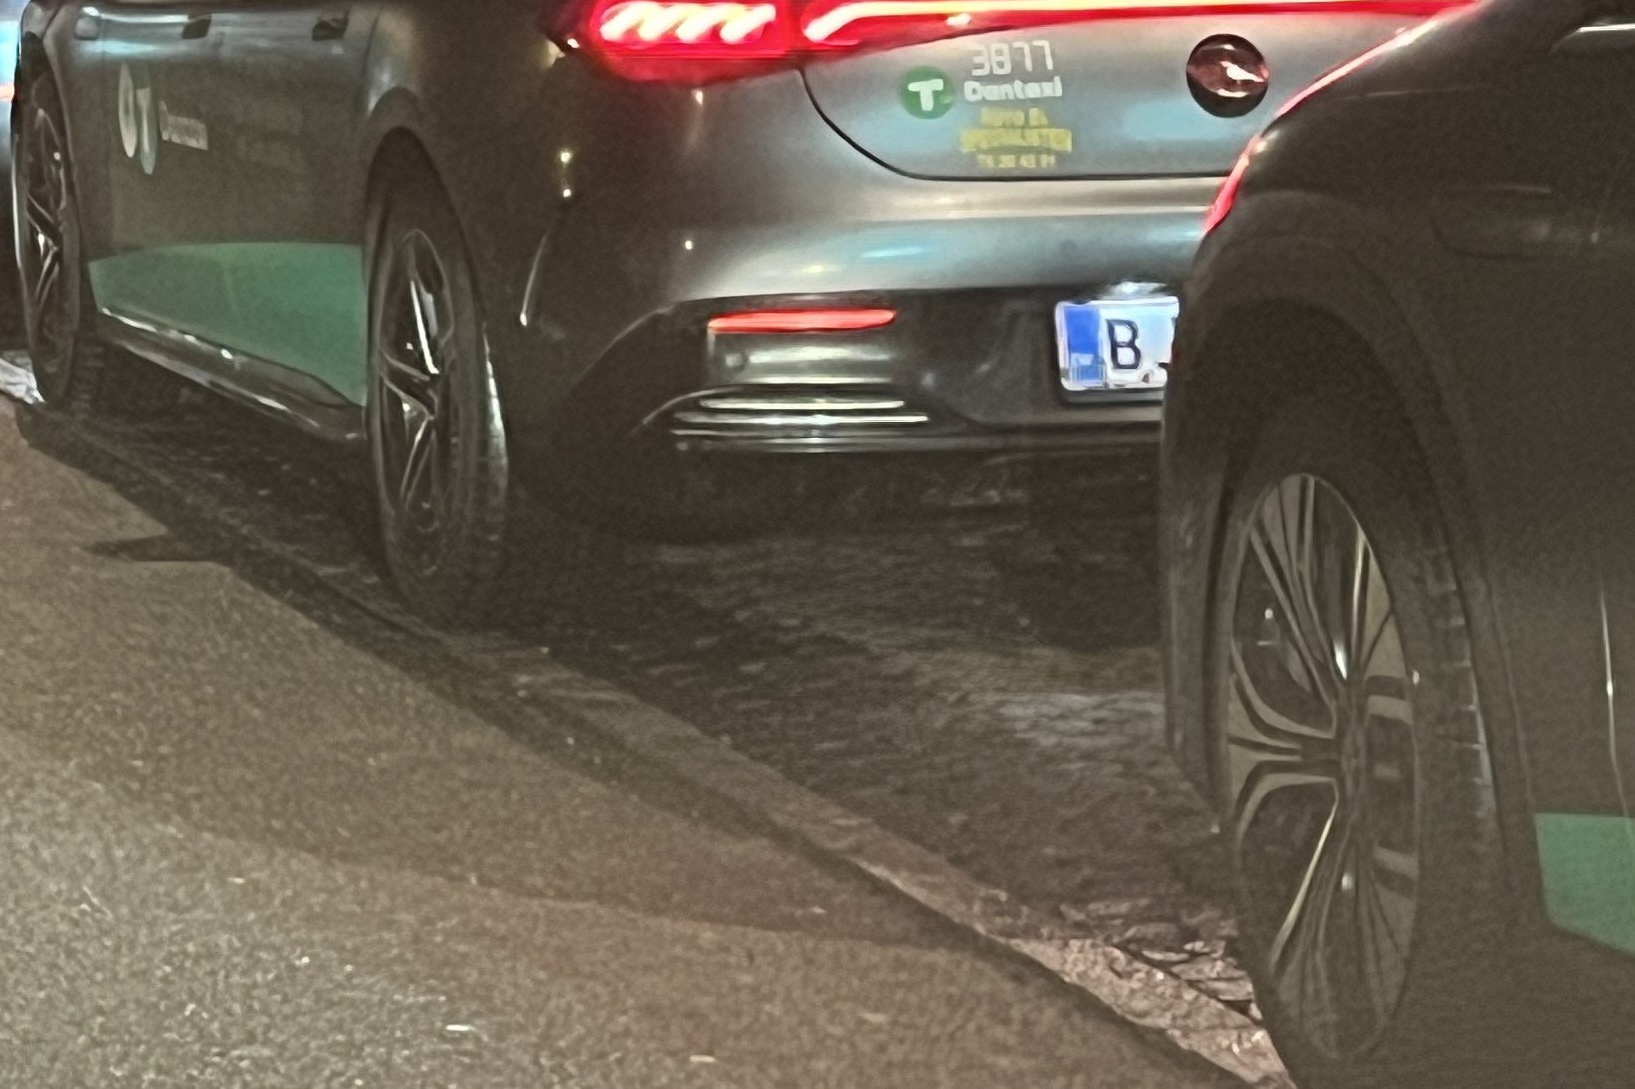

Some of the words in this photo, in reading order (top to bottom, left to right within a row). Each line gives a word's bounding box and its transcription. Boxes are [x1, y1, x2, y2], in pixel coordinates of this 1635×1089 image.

[968, 40, 1054, 76] 3877
[907, 78, 944, 111] T
[1106, 318, 1164, 370] B
